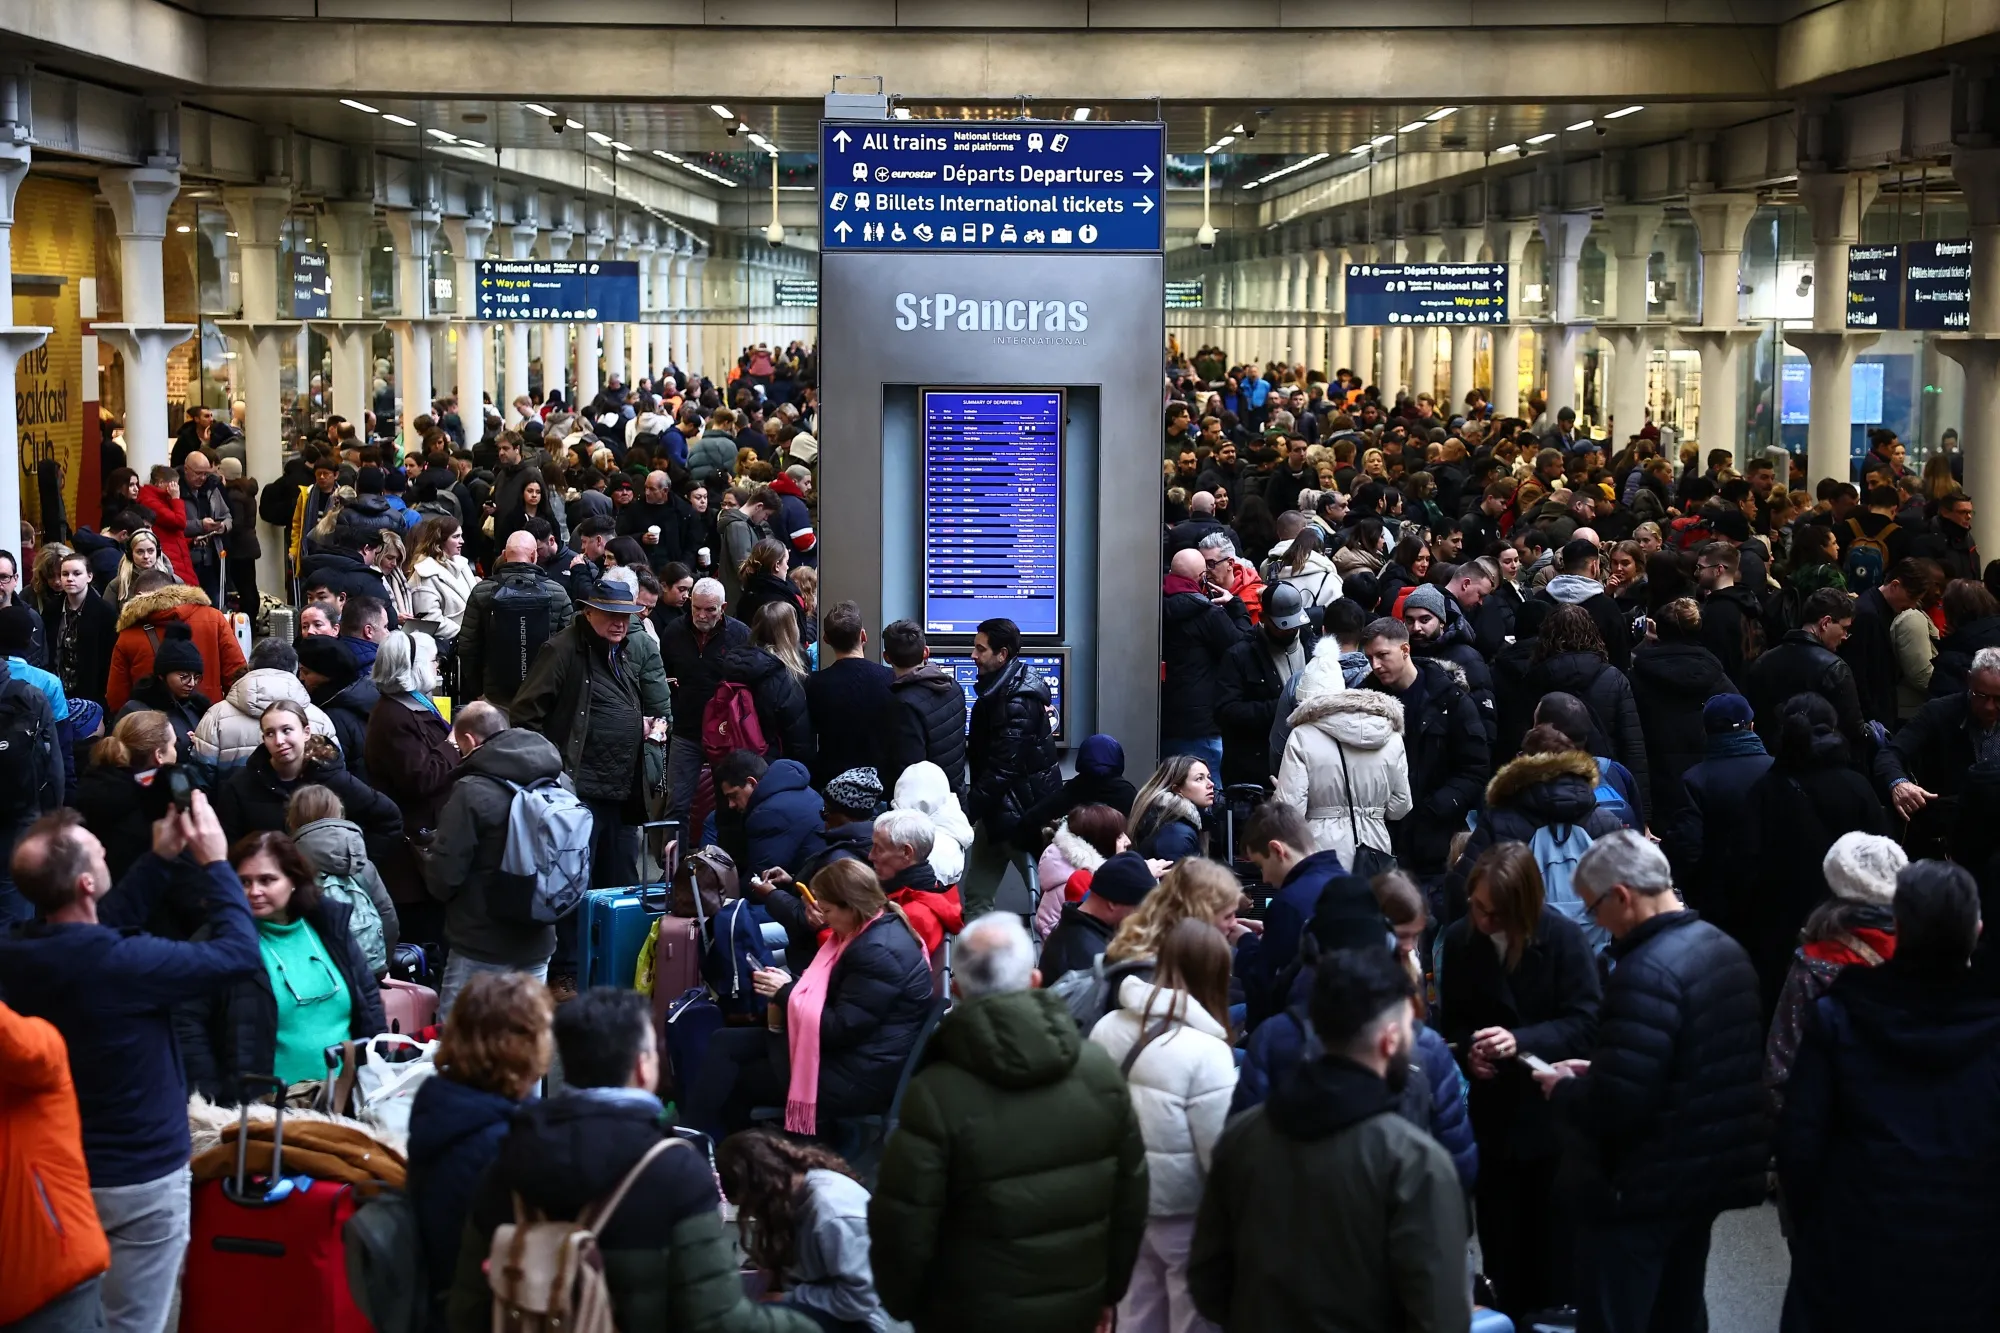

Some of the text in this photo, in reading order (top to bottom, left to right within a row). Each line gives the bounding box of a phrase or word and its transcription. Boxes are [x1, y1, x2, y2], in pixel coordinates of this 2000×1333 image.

[954, 131, 1021, 141] National tickets
[863, 133, 948, 151] All trains
[953, 142, 1015, 153] and platforms
[891, 163, 1124, 187] eurostar Départs Departures
[876, 193, 1124, 213] Billets International tickets
[495, 263, 551, 274] National Rail
[1403, 265, 1439, 276] Départs
[1440, 265, 1490, 276] Departures
[496, 279, 531, 289] Way out
[1433, 281, 1490, 291] National Rail
[496, 293, 519, 303] Taxis
[1455, 297, 1474, 307] Way
[934, 293, 1089, 333] Pancras
[992, 336, 1087, 347] INTERNATIONAL
[16, 380, 68, 425] eakfast
